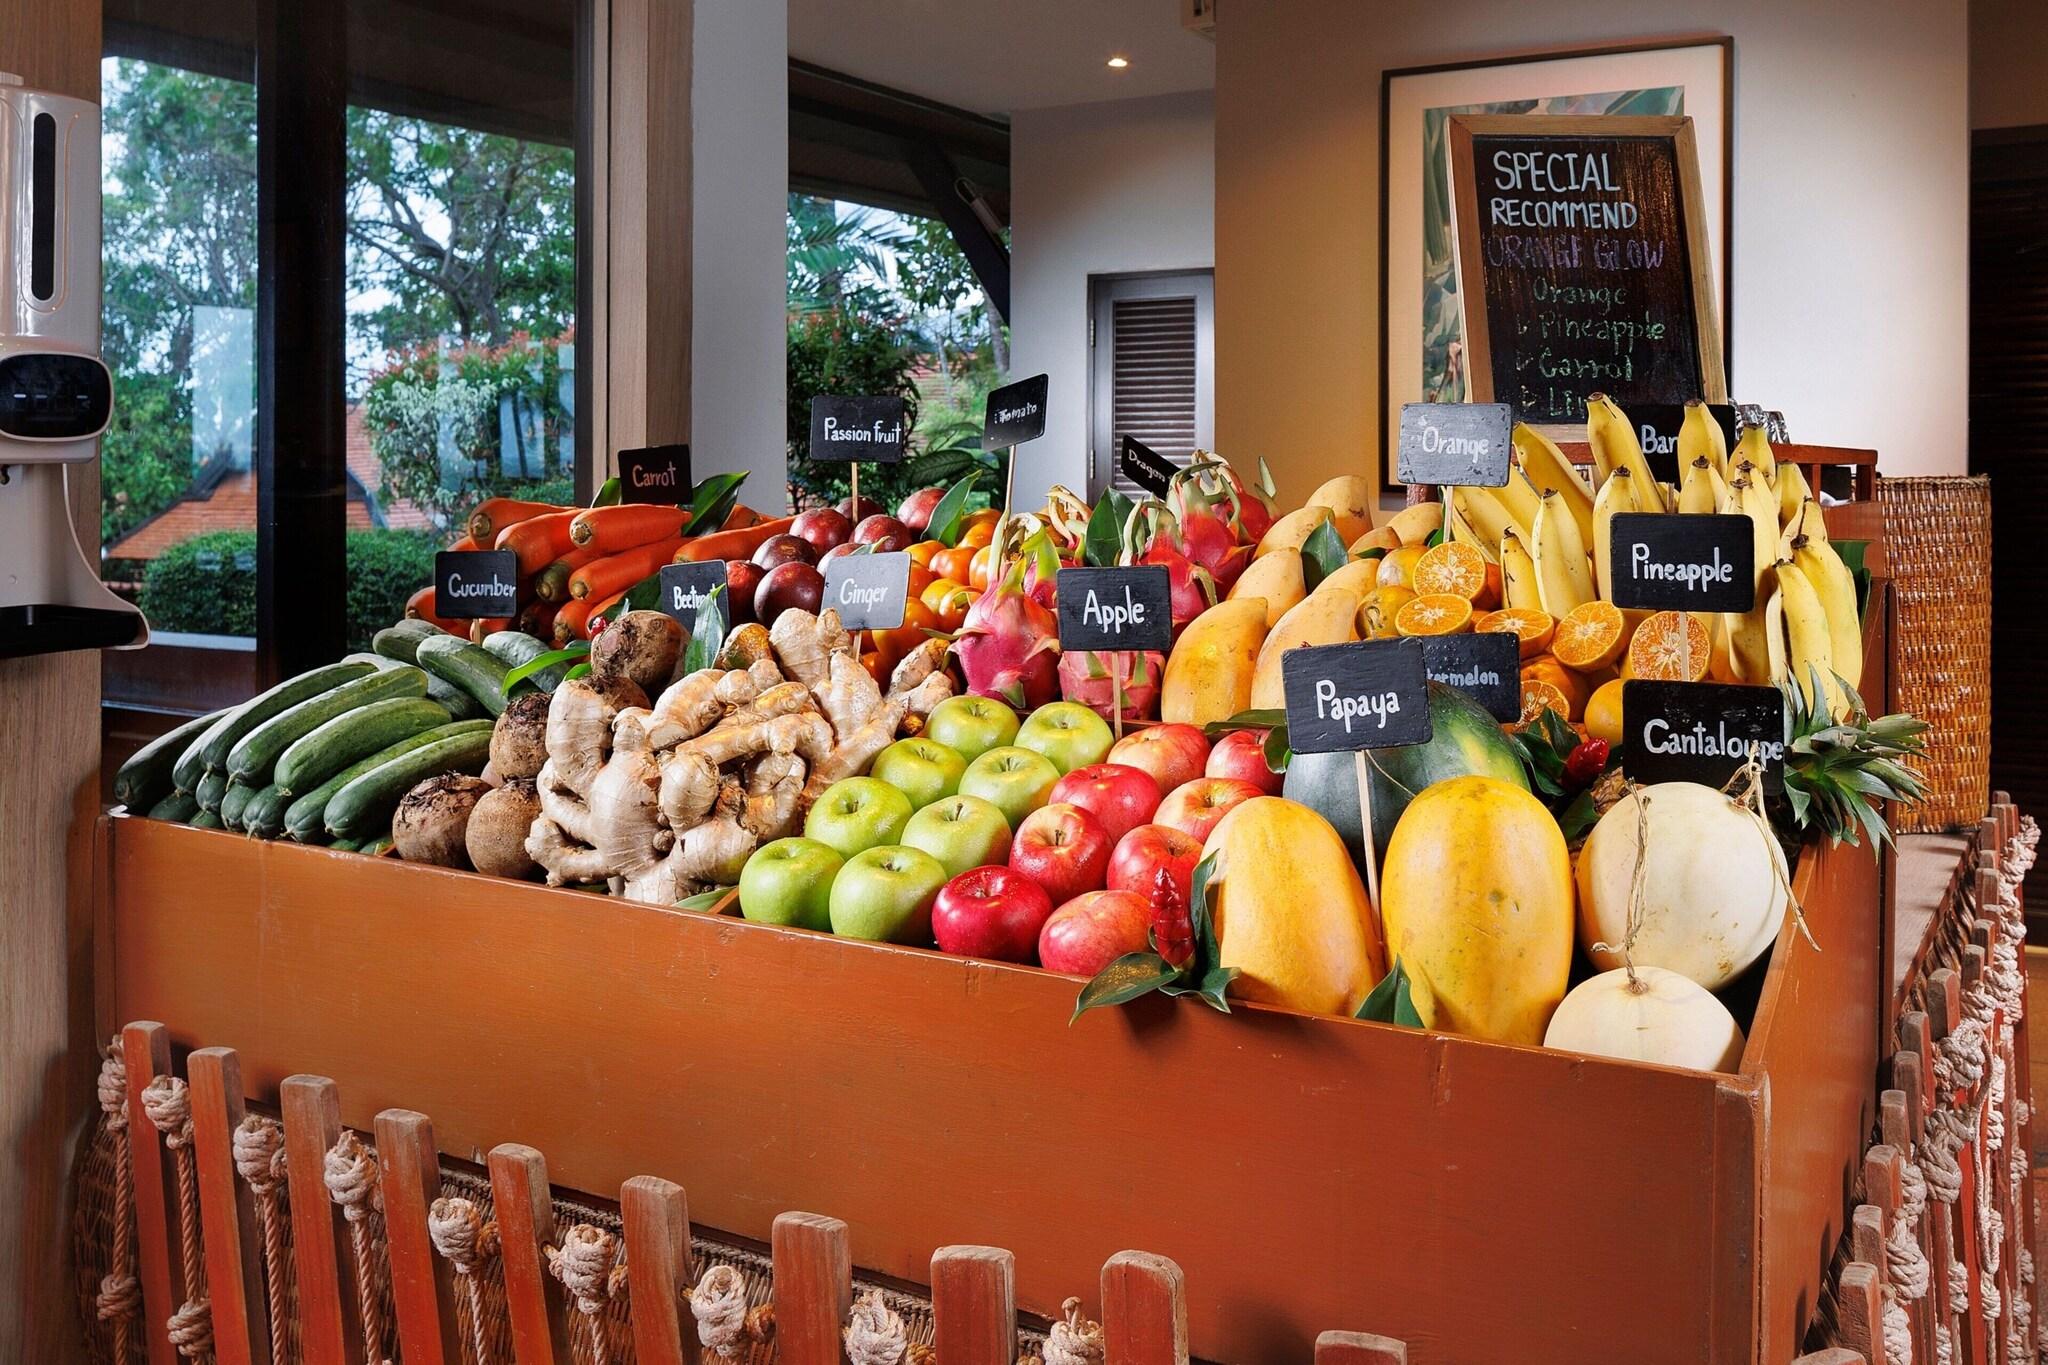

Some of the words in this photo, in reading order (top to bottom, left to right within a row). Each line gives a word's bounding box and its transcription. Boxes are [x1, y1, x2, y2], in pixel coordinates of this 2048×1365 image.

[1493, 150, 1621, 193] SPECIAL
[1490, 197, 1637, 230] RECOMMEND
[1594, 234, 1664, 271] GLOW
[1538, 310, 1666, 356] Pineapple
[823, 416, 872, 442] Passion
[873, 420, 902, 444] fruit
[998, 402, 1038, 424] Tomato
[1422, 426, 1490, 464] Orange
[632, 461, 677, 488] Carrot
[1128, 449, 1166, 483] Dragon
[448, 572, 517, 598] Cucumber
[1632, 542, 1734, 593] Pineapple
[840, 578, 889, 613] Ginger
[1083, 584, 1145, 634] Apple
[1315, 679, 1401, 734] Papaya
[1643, 718, 1785, 773] Cantaloupe
